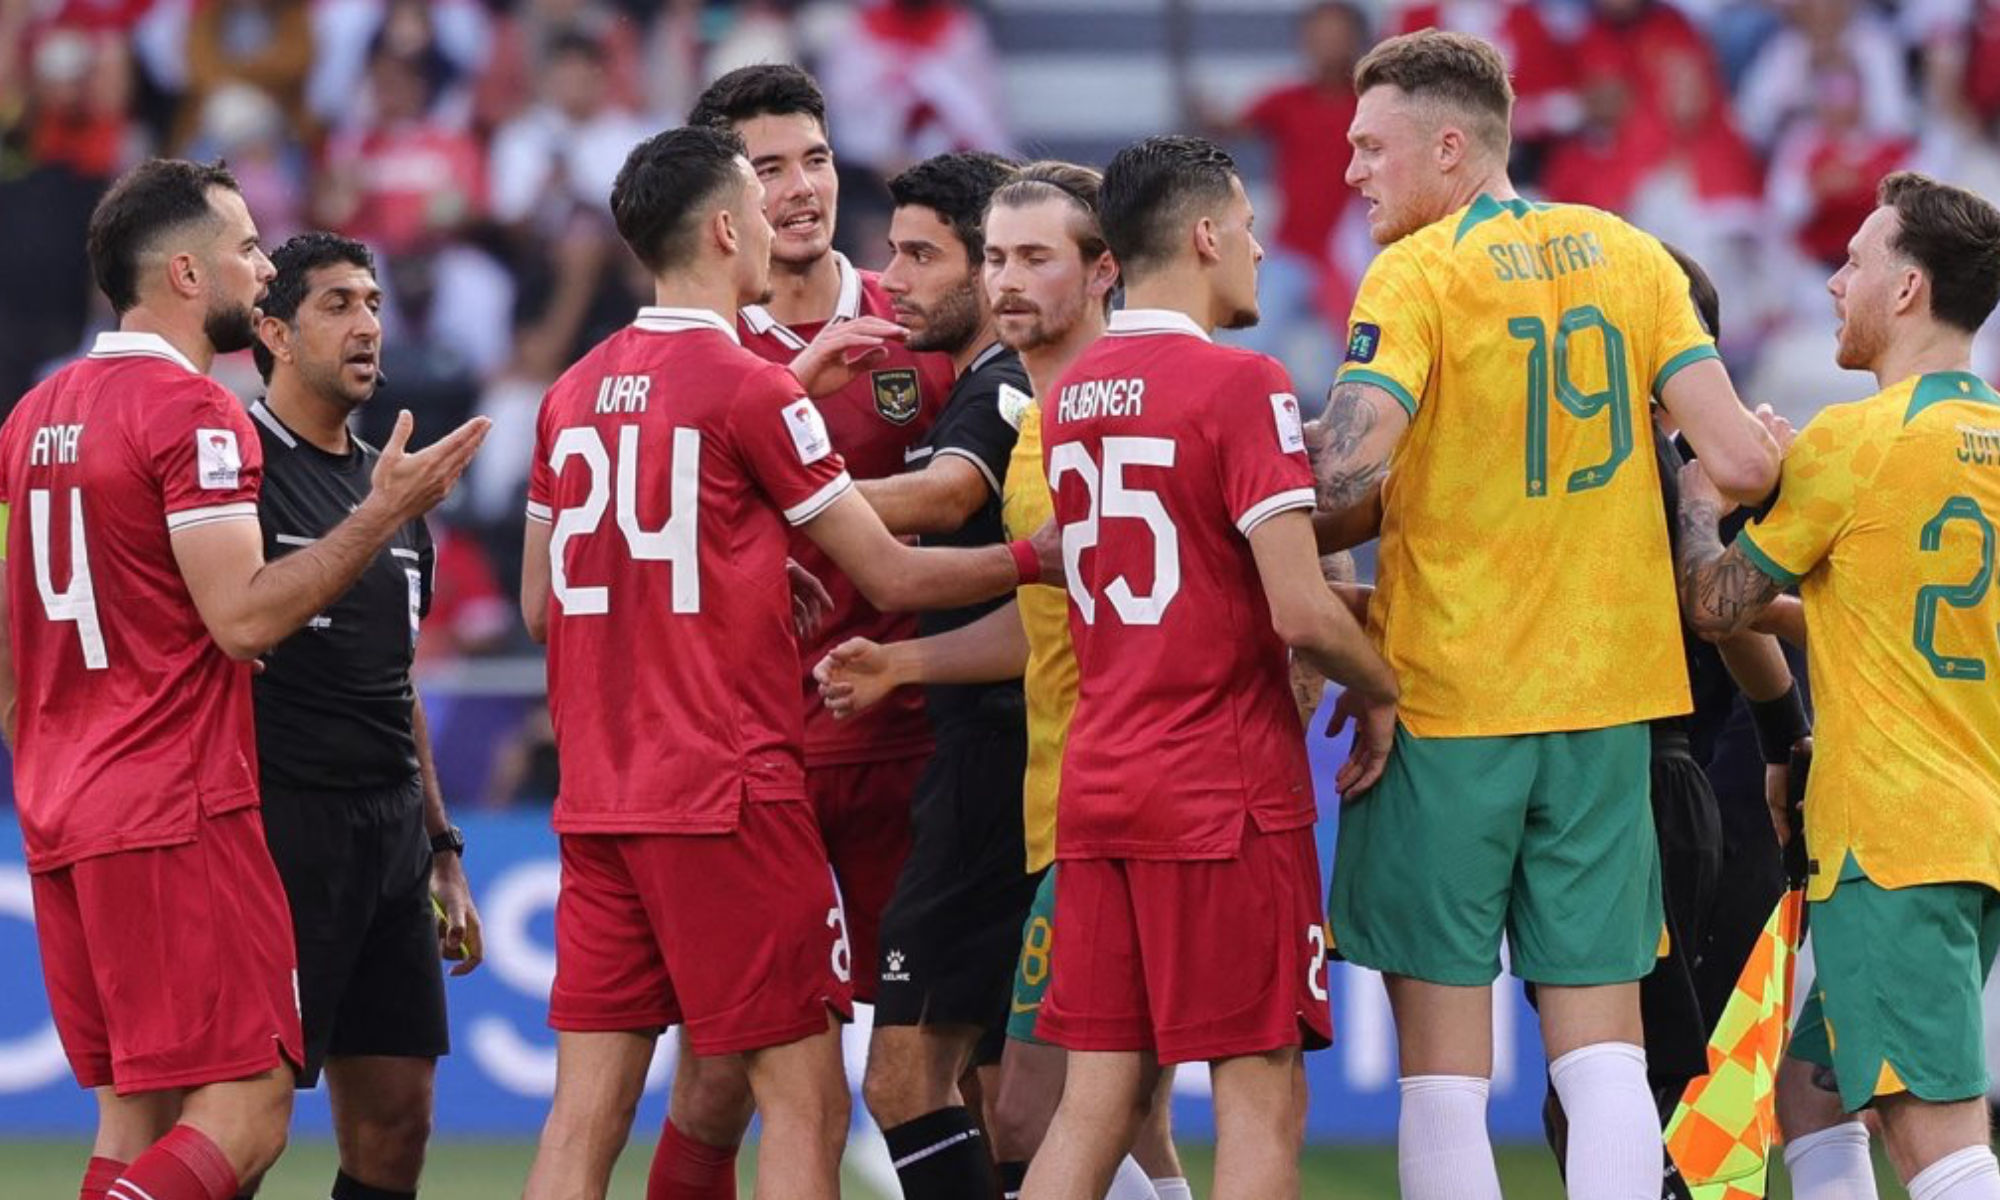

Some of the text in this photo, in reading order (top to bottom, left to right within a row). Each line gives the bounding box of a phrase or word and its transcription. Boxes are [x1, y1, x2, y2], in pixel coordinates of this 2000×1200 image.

[31, 424, 84, 466] AMA
[595, 375, 651, 414] IVAR
[1058, 378, 1145, 424] HUBNER
[1508, 304, 1634, 497] 19
[30, 489, 108, 670] 4
[549, 425, 700, 615] 24
[1049, 436, 1181, 626] 25
[1913, 495, 2000, 680] 2
[1023, 916, 1051, 986] 8
[1308, 924, 1328, 1001] 2
